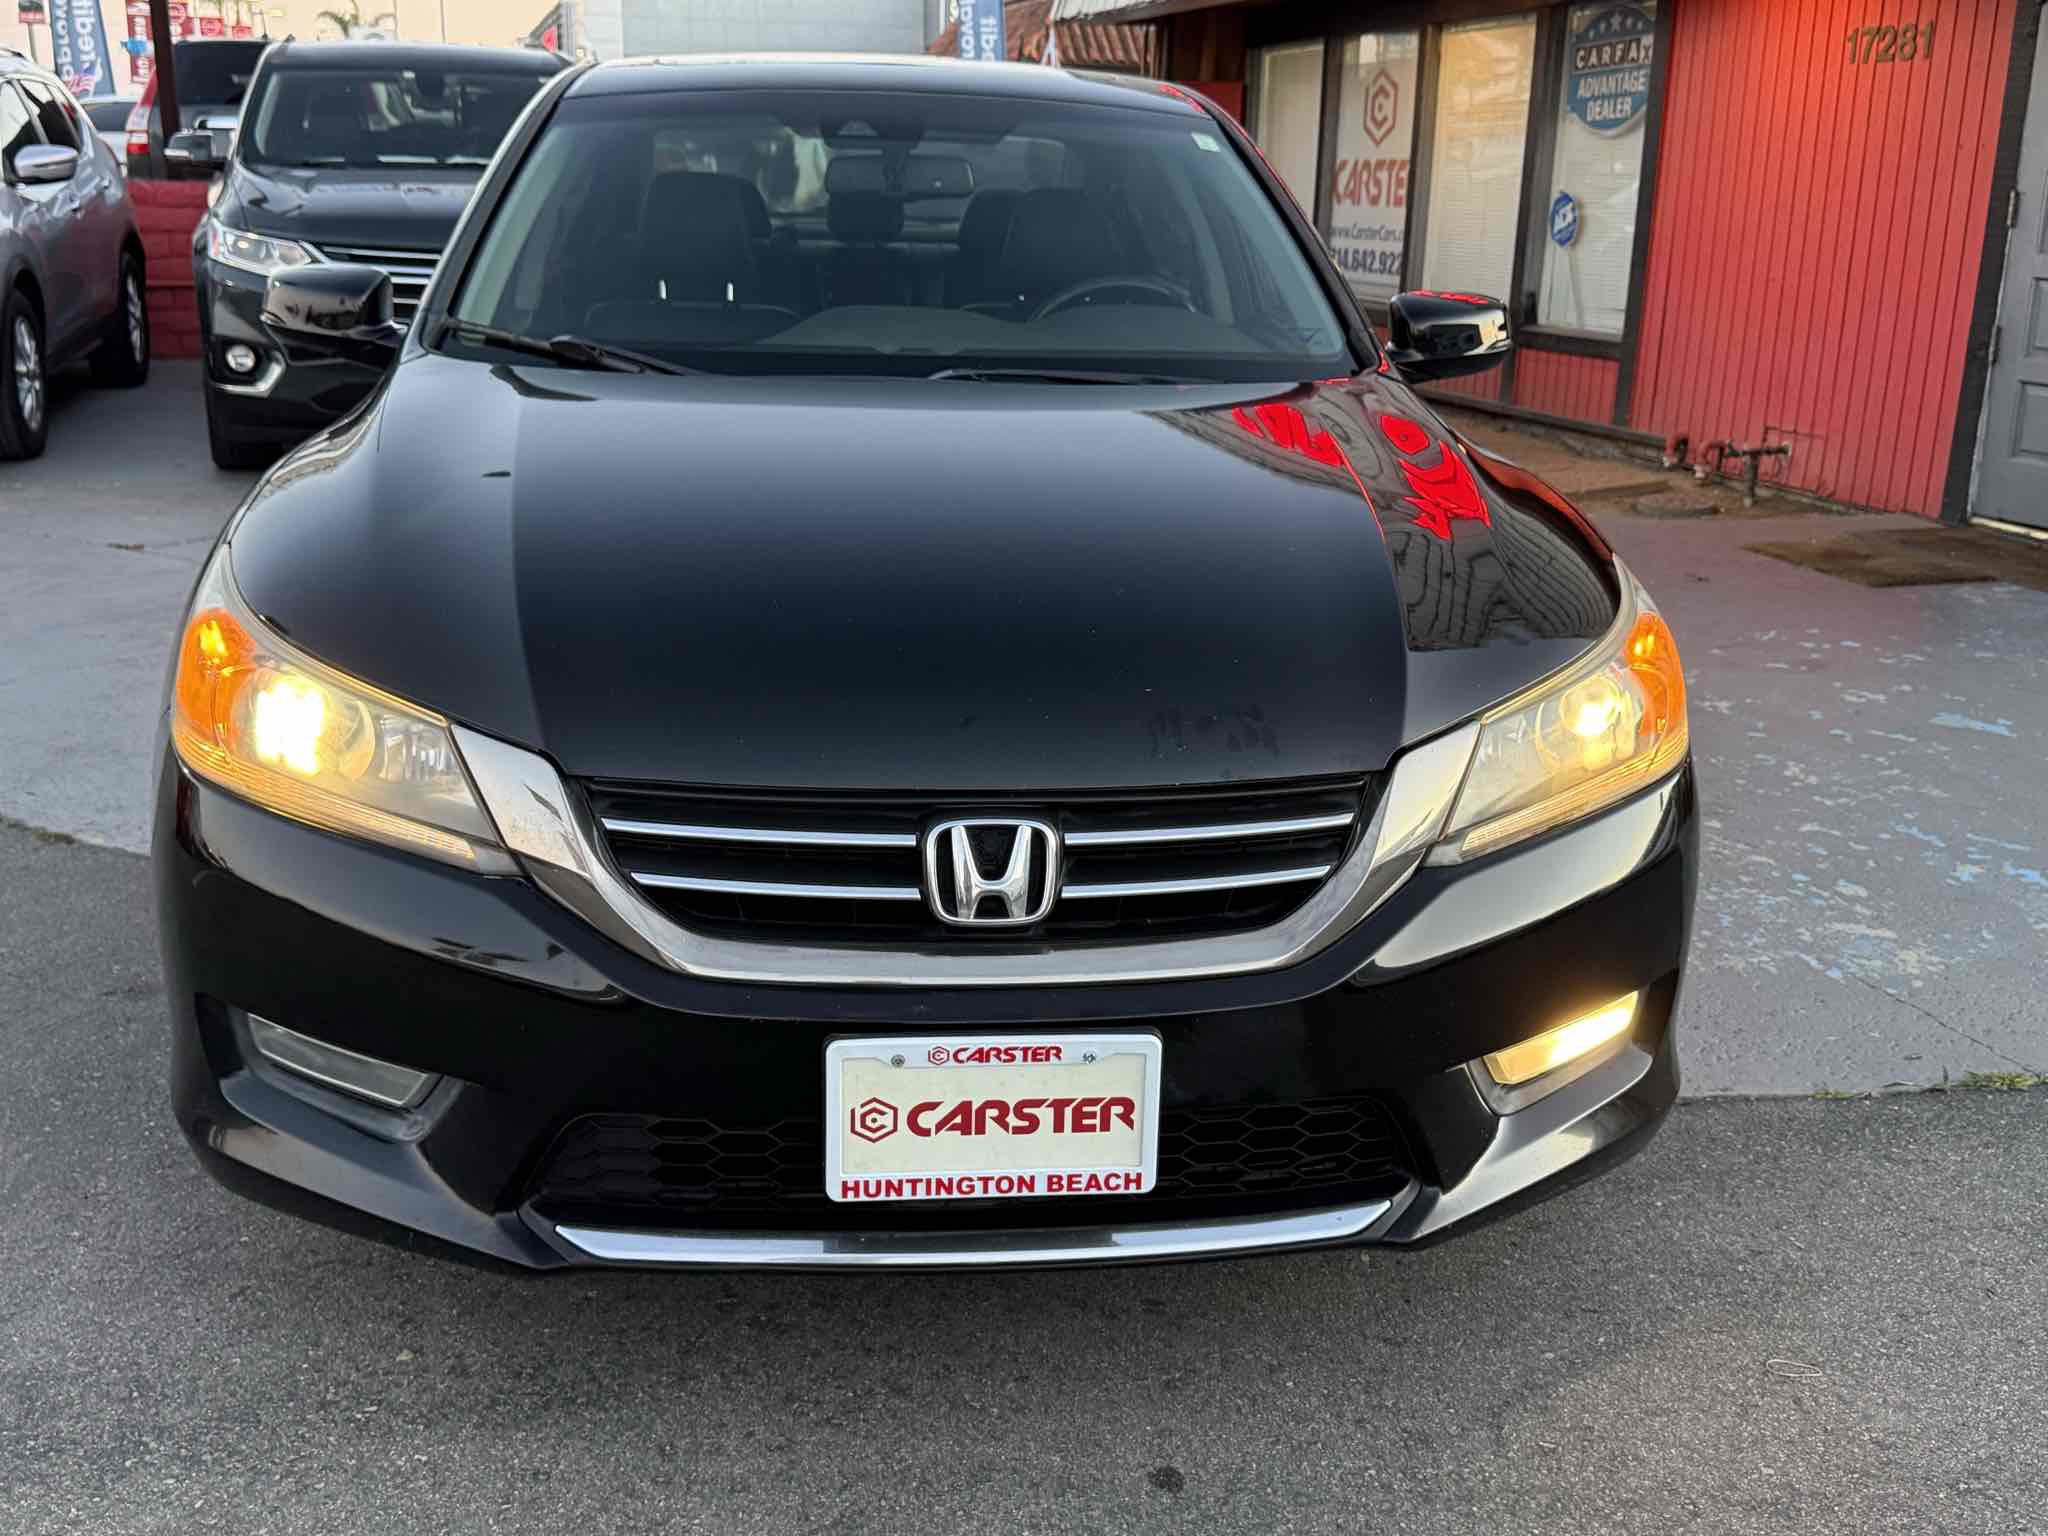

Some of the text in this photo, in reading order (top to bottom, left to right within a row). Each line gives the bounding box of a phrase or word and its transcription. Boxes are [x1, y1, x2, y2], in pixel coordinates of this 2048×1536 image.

[1575, 35, 1653, 70] CARFAX
[1847, 18, 1935, 64] 17281
[1577, 69, 1648, 98] ADVANTAGE
[1586, 96, 1632, 121] DEALER
[953, 1046, 1062, 1064] CARSTER
[906, 1096, 1136, 1137] CARSTER
[841, 1172, 1143, 1199] HUNTINGTON BEACH
